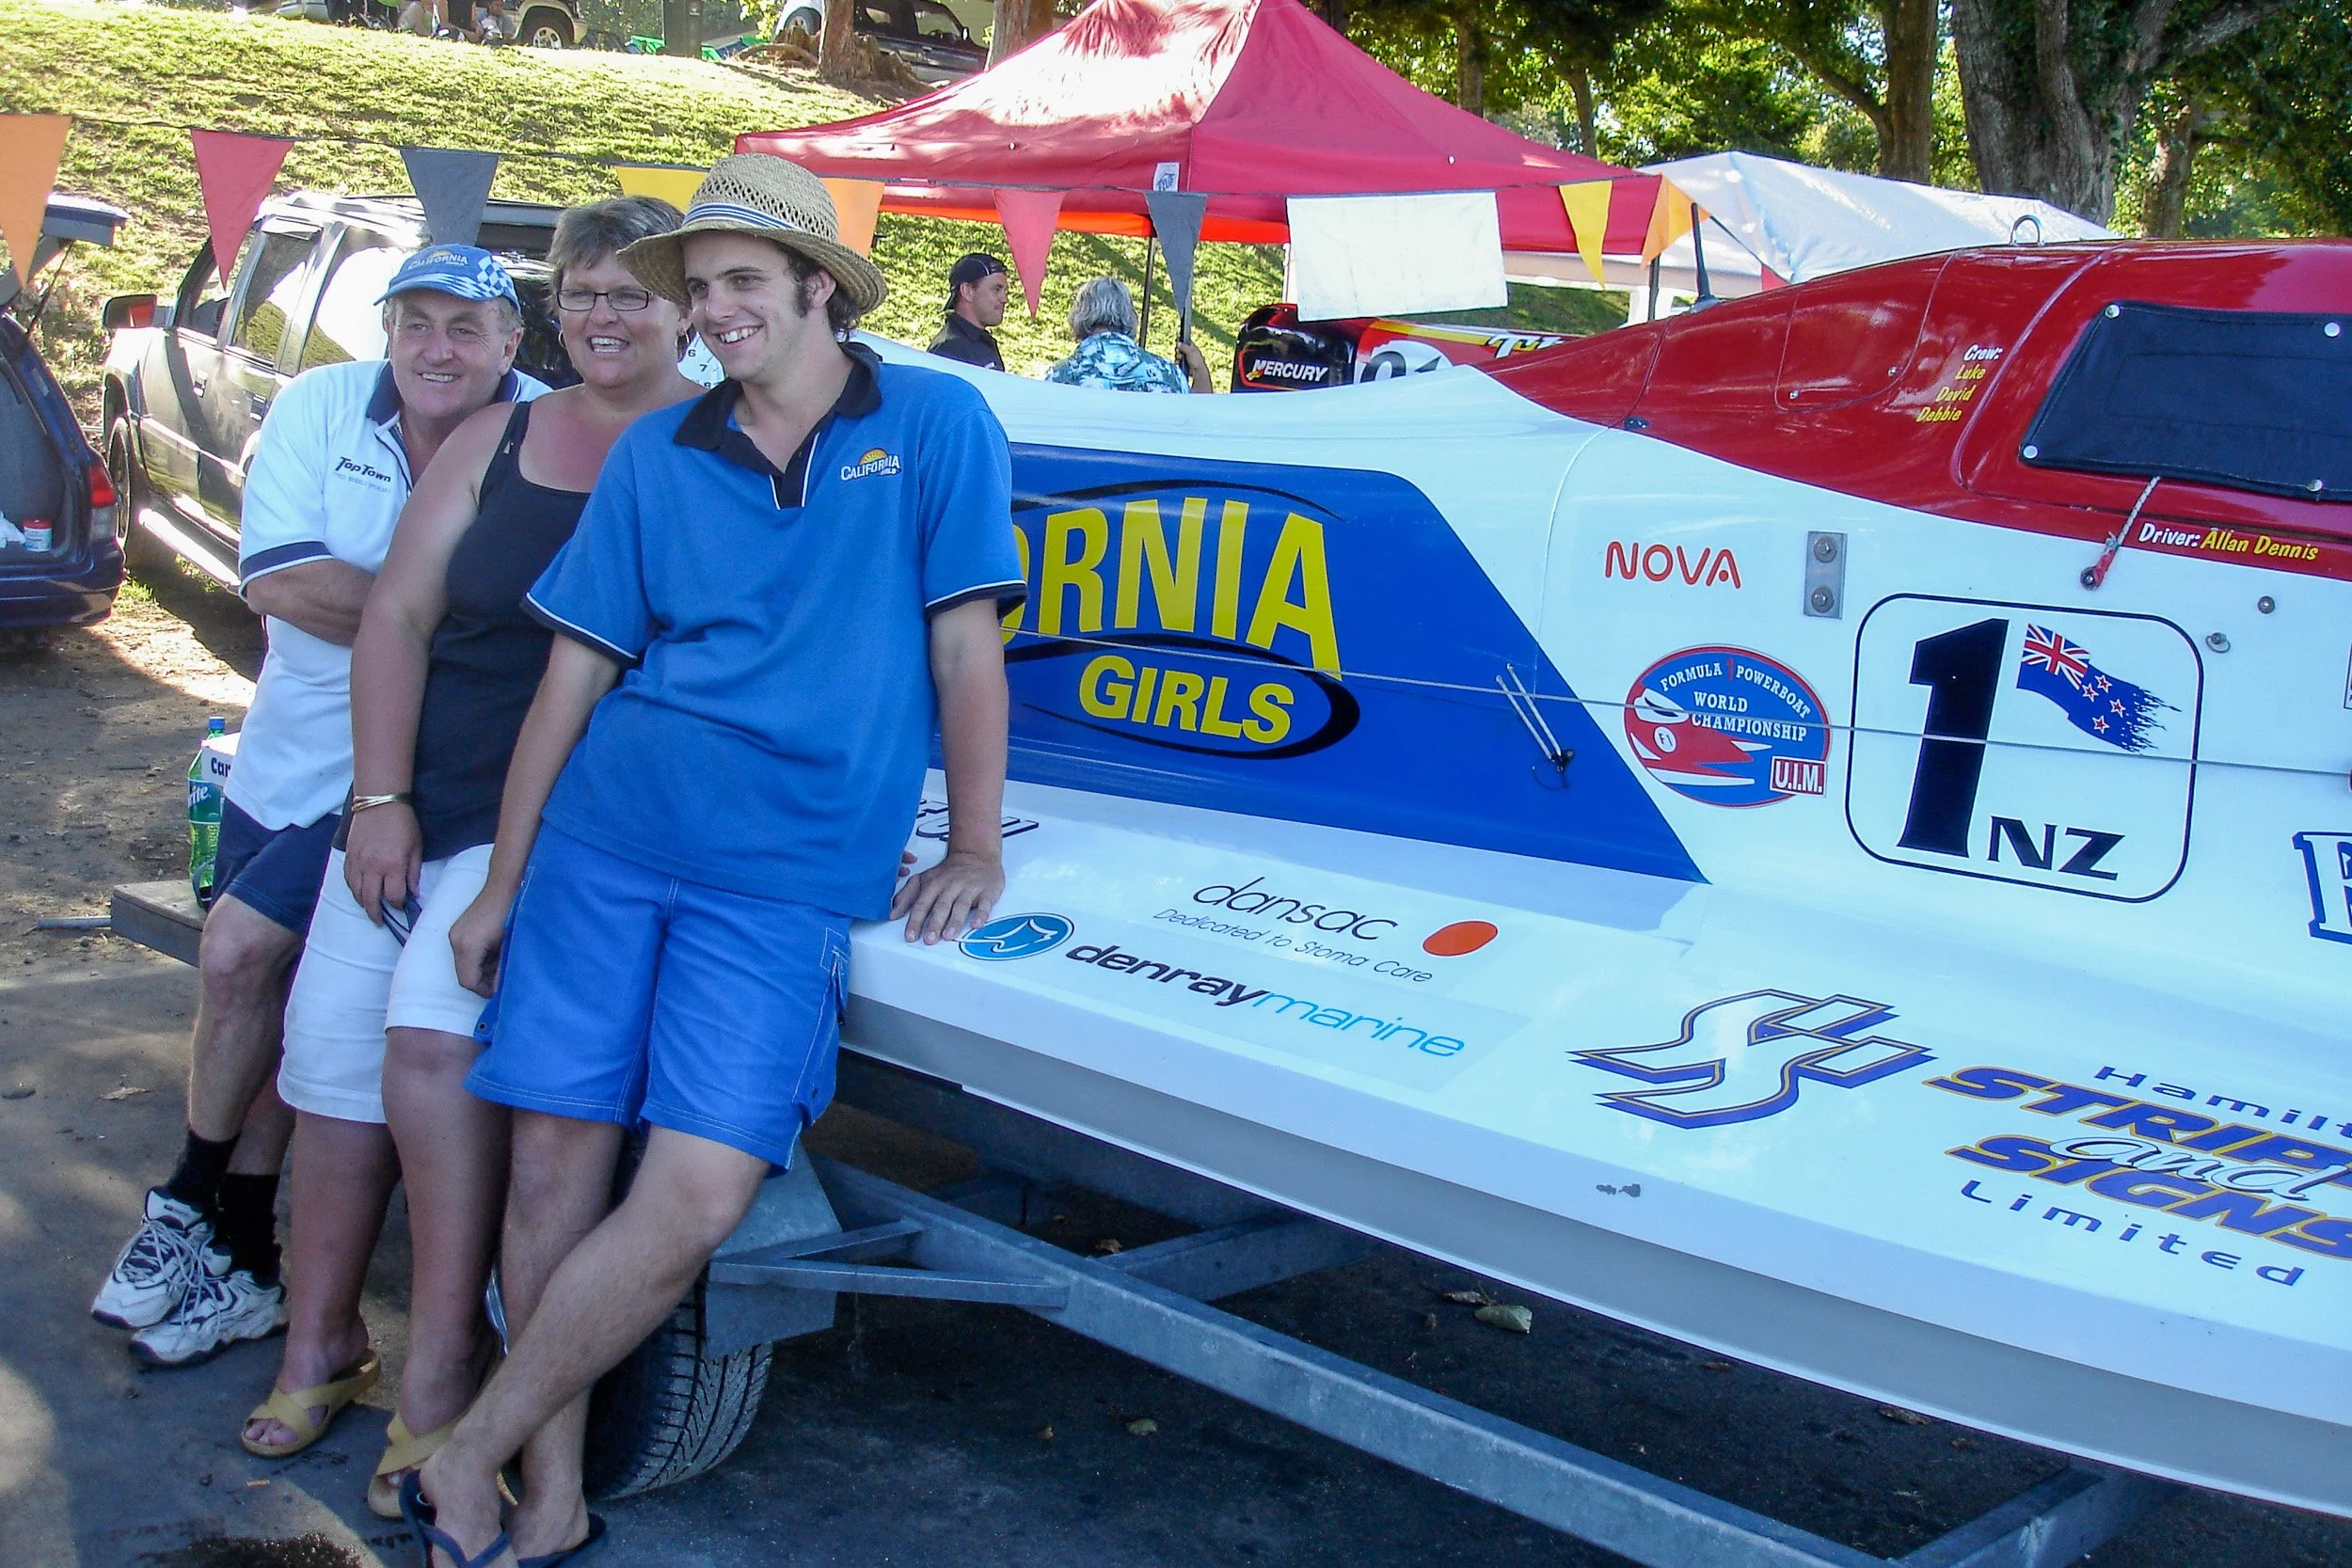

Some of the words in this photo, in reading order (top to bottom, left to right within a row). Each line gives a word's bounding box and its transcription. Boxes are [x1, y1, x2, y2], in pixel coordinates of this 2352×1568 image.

[1251, 358, 1328, 382] MERCURY
[1954, 363, 1987, 380] Luke
[1915, 404, 1963, 422] Debbie
[1934, 384, 1978, 403] David
[840, 454, 901, 481] CALIFORNIA
[2137, 522, 2201, 548] Driver:
[2200, 529, 2249, 553] Allan
[2252, 534, 2319, 562] Dennis
[1604, 540, 1741, 590] NOVA
[1078, 655, 1295, 744] GIRLS
[1660, 661, 1724, 692] FORMULA
[1735, 664, 1812, 720] POWERBOAT
[1692, 690, 1749, 714] WORLD
[1691, 712, 1808, 743] CHAMPIONSHIP
[1896, 617, 2010, 859] 1
[1986, 815, 2126, 881] NZ
[1773, 759, 1823, 793] U.I.M.
[1192, 876, 1399, 941] dansac
[1152, 908, 1273, 941] Dedicated
[1264, 932, 1293, 947] to
[1294, 941, 1370, 967] Stoma
[1373, 960, 1434, 983] Care
[2047, 1135, 2351, 1201] and
[1944, 1134, 2352, 1261] SIGNS
[1960, 1179, 2306, 1287] Limited
